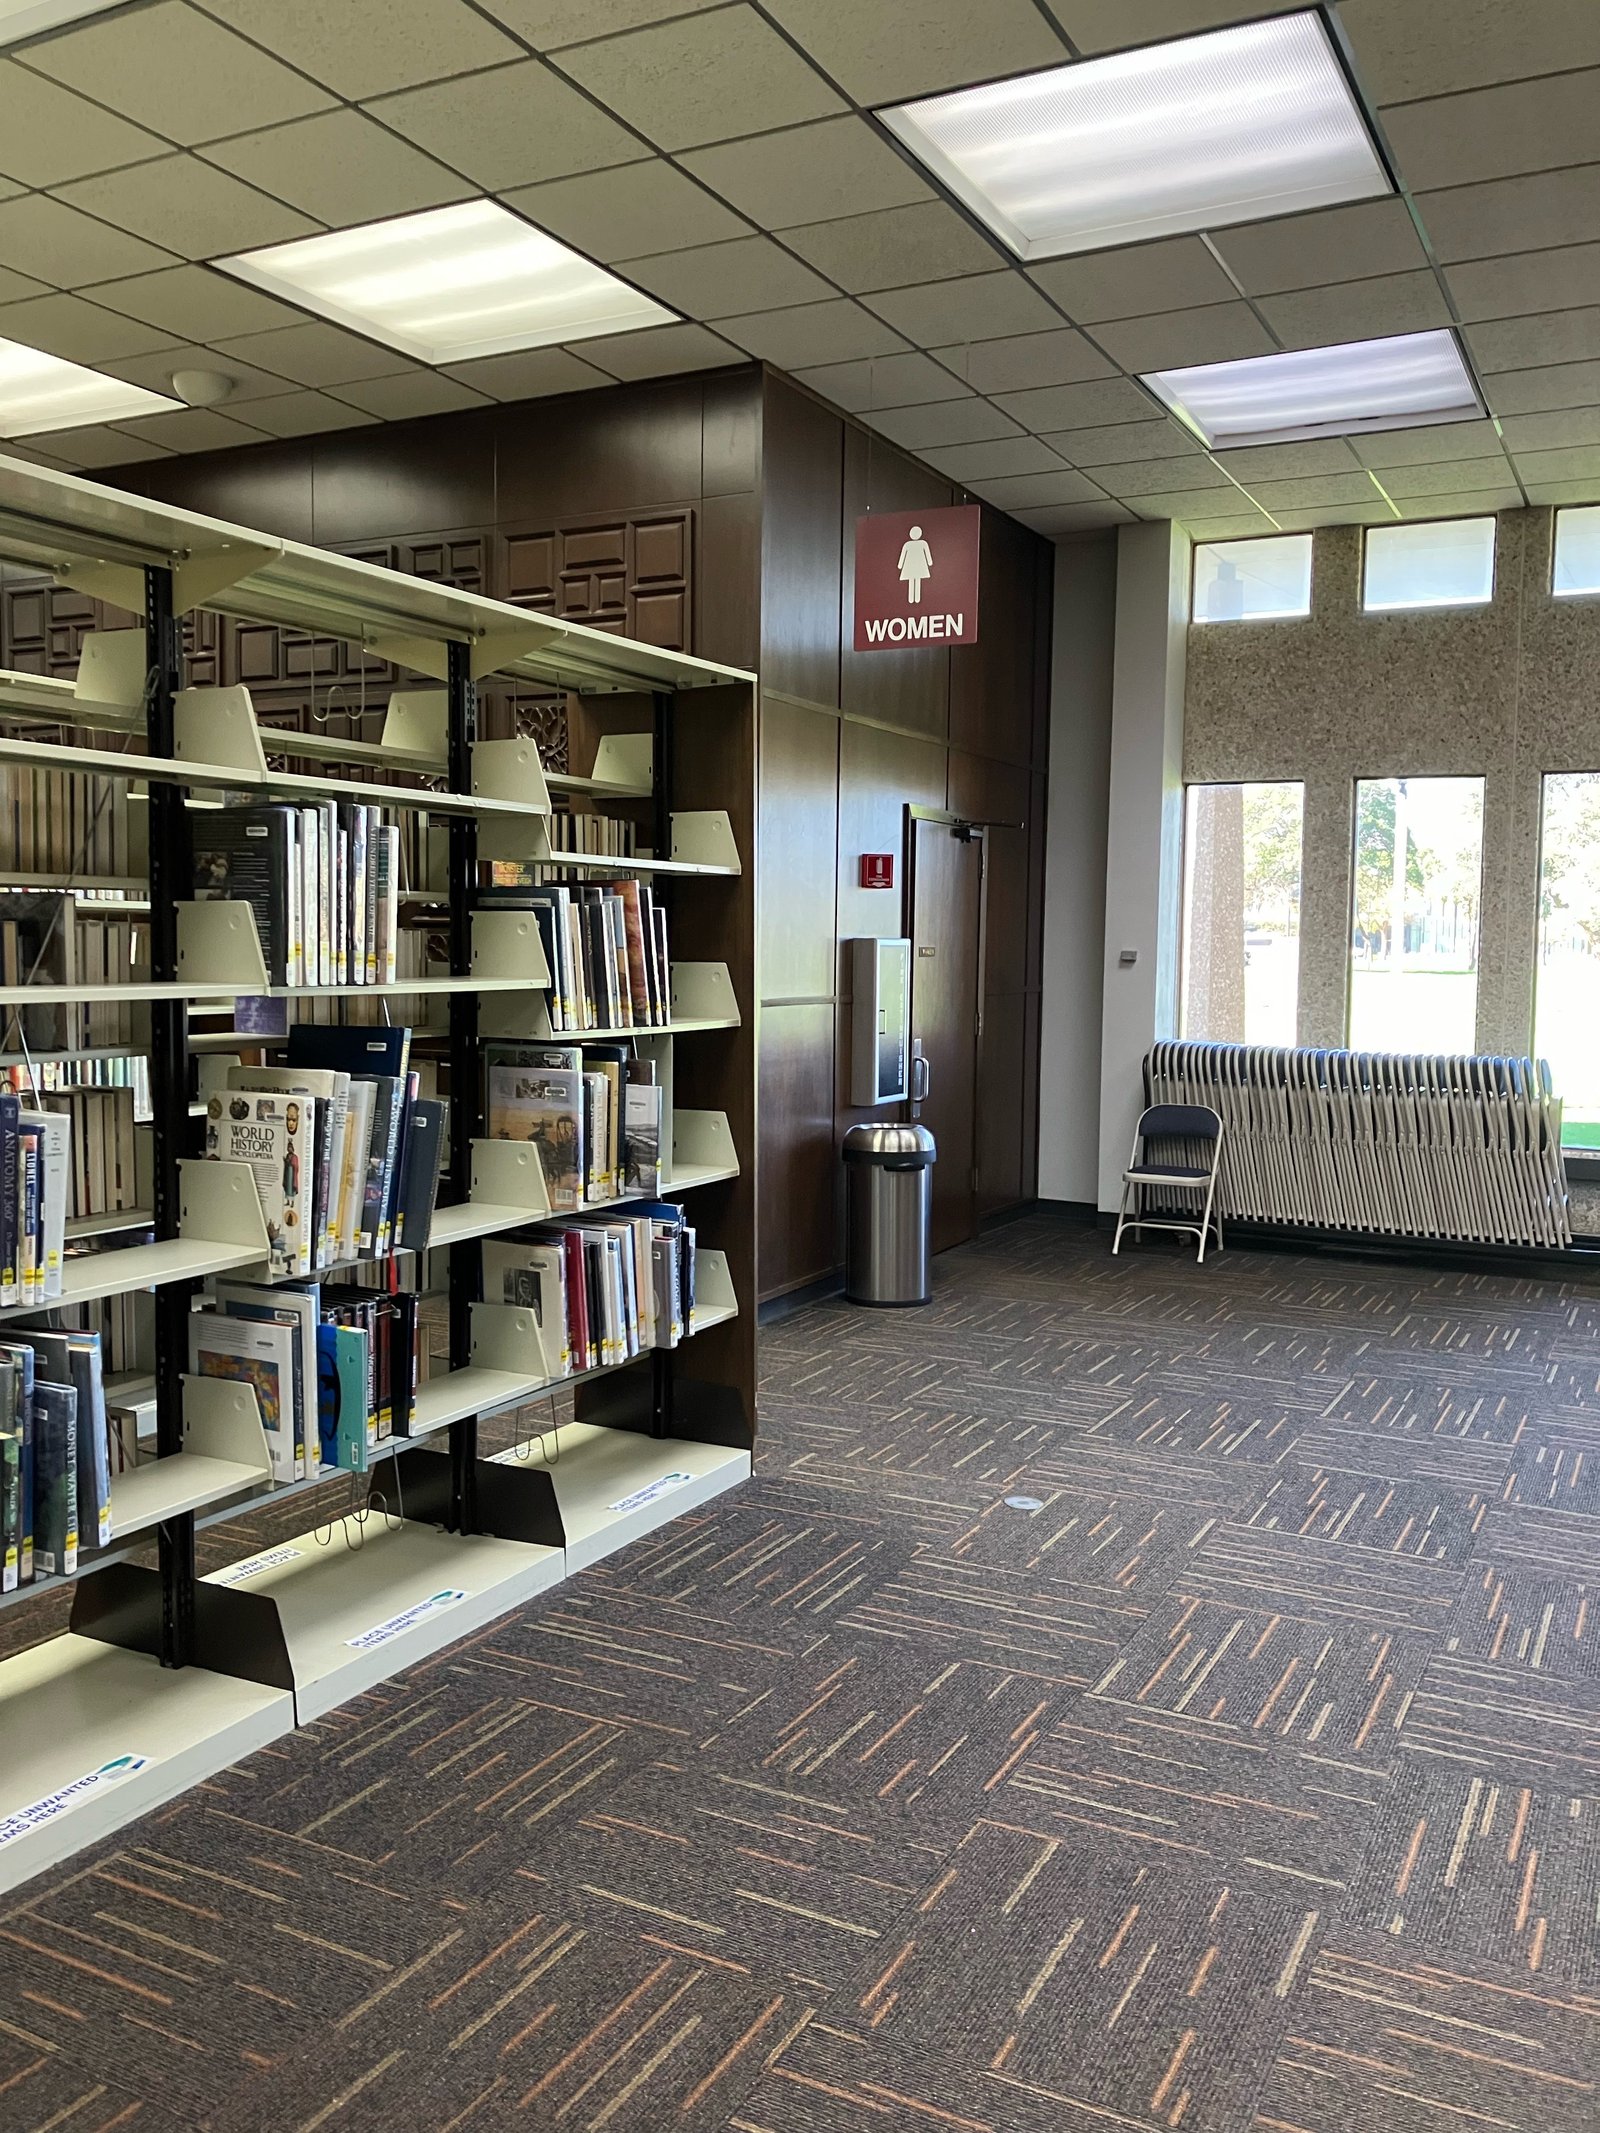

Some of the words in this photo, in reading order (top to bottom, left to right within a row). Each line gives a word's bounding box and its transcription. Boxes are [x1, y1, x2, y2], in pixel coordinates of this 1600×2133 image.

[864, 612, 964, 643] WOMEN
[369, 833, 377, 878] HUNDRED
[230, 1124, 275, 1141] WORLD
[230, 1138, 275, 1153] HISTORY
[388, 1106, 400, 1154] WORLD
[4, 1129, 15, 1196] ANATOMY
[26, 1153, 37, 1186] LIONEL
[230, 1150, 274, 1160] ENCYCLOPEDIA
[380, 1156, 394, 1209] HISTORY
[66, 1420, 77, 1464] MONET
[66, 1471, 77, 1513] WATER
[350, 1630, 385, 1647] PLACE
[381, 1602, 433, 1630] UNWANTED
[362, 1631, 395, 1649] ITEMS
[393, 1619, 417, 1632] HERE
[0, 1818, 20, 1834] CE
[18, 1775, 99, 1819] UNWANTED
[29, 1802, 69, 1823] HERE
